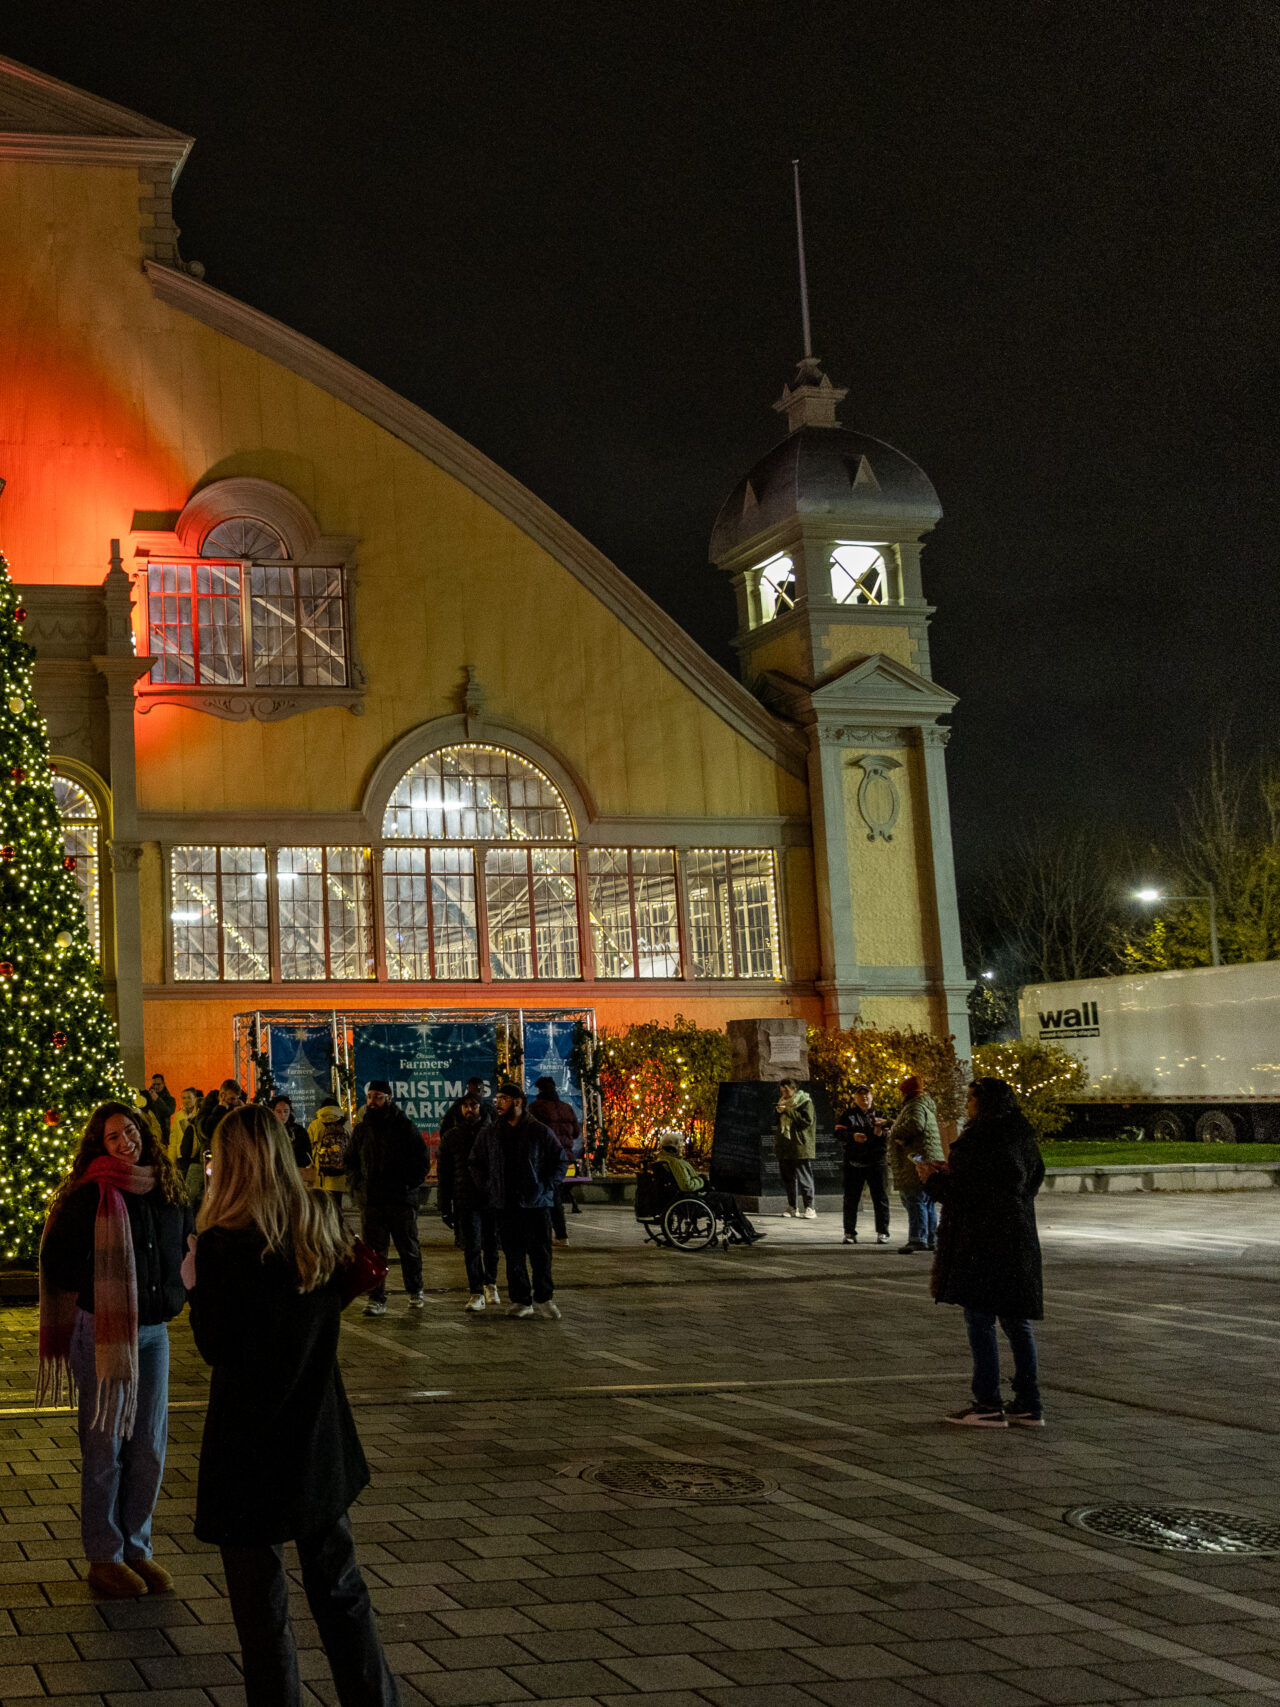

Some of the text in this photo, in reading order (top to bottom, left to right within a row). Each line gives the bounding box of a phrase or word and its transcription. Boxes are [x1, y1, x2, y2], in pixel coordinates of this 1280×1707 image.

[1038, 1002, 1098, 1028] wall
[400, 1059, 452, 1069] Farmers'
[364, 1080, 491, 1098] RISTMS
